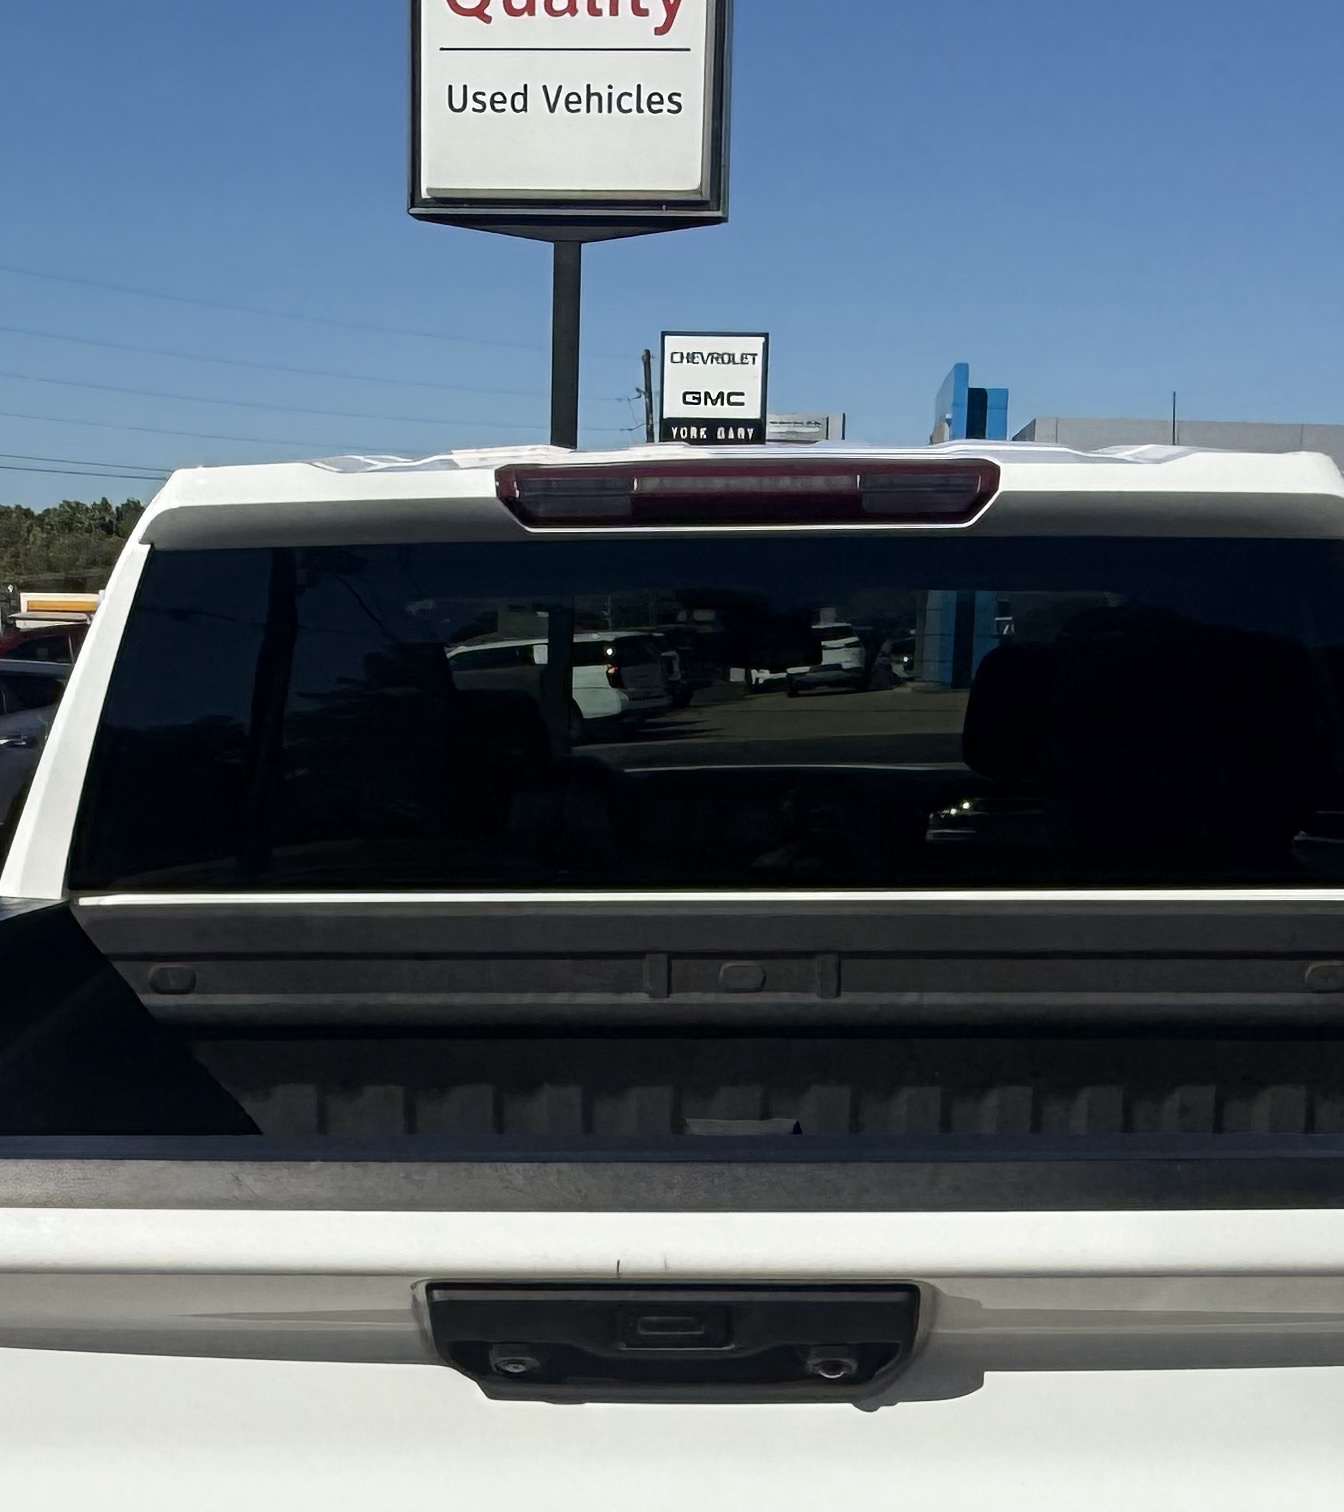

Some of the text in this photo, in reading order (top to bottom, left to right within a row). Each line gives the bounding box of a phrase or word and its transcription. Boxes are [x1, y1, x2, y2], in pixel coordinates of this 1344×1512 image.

[447, 83, 683, 115] Used Vehicles
[670, 351, 758, 365] CHEVROLET
[682, 391, 745, 406] GMC
